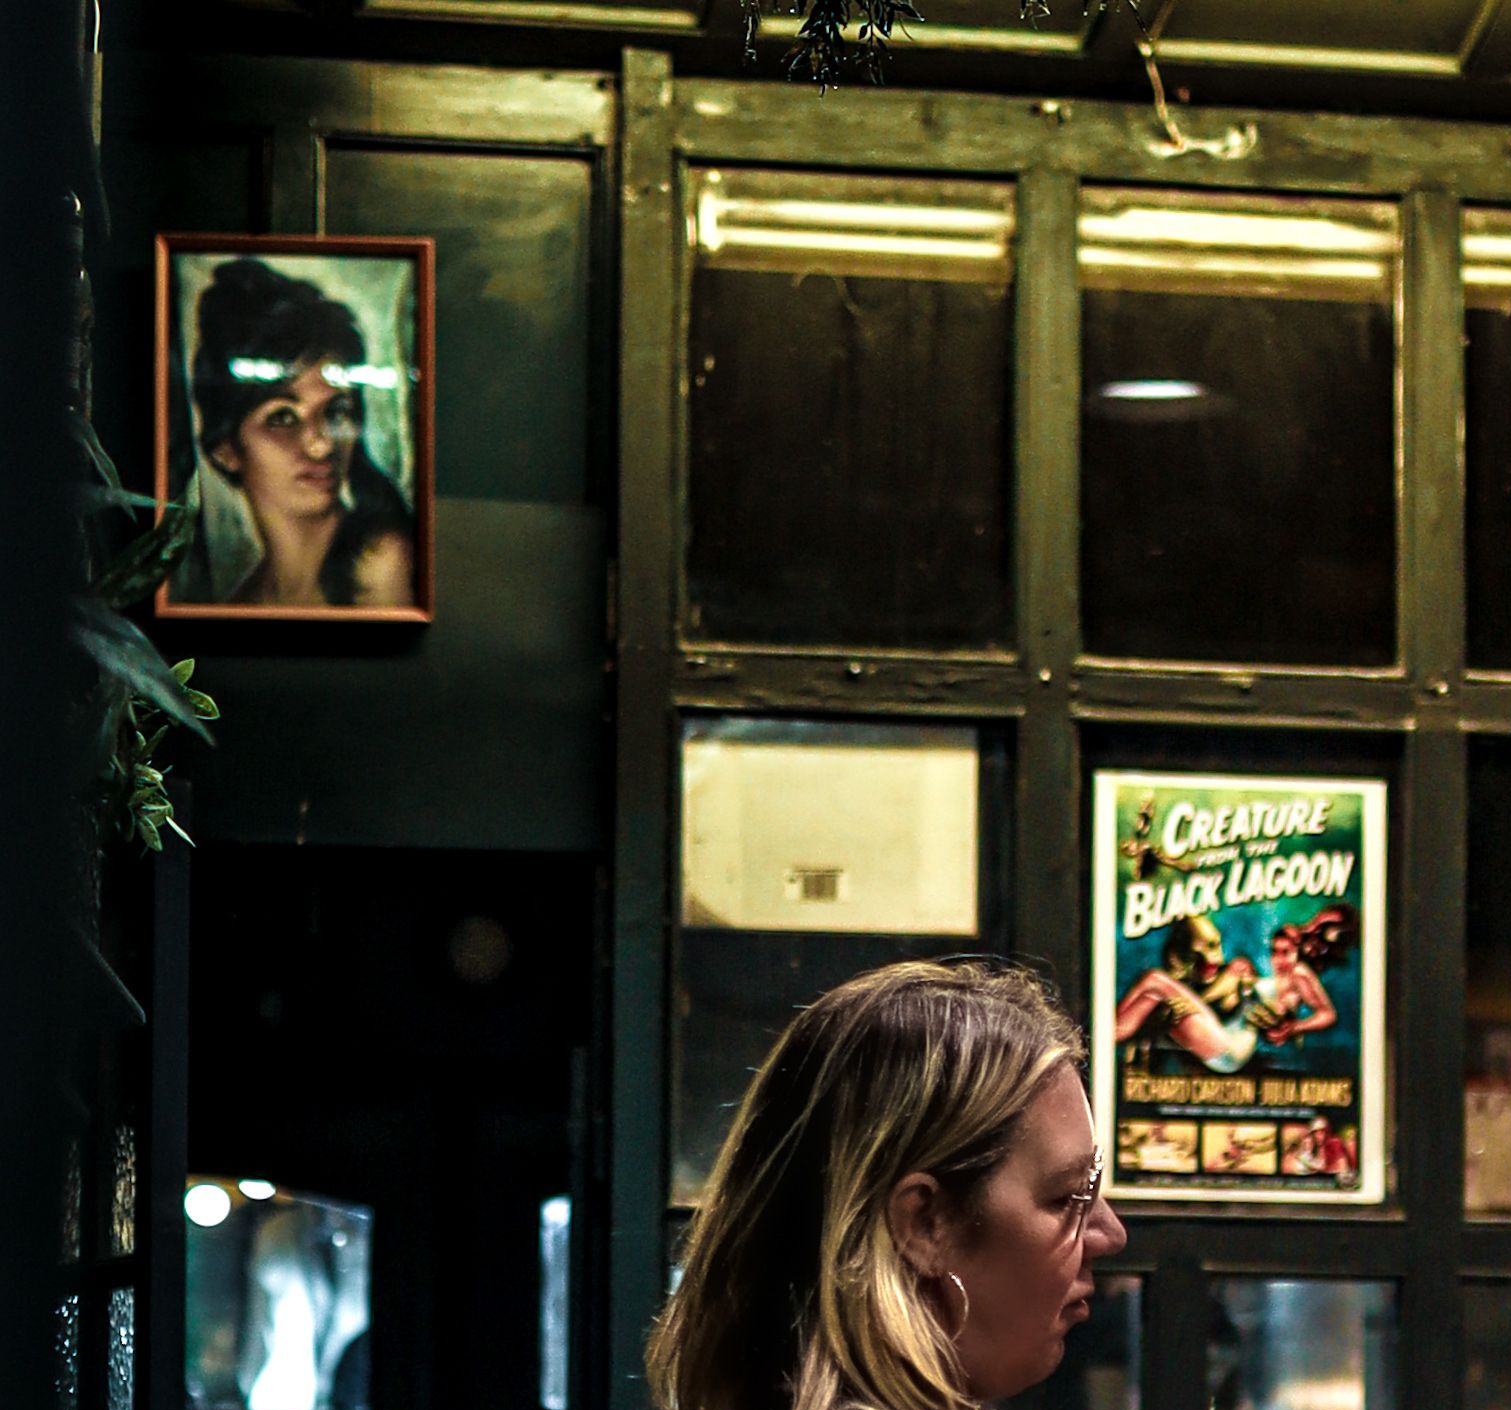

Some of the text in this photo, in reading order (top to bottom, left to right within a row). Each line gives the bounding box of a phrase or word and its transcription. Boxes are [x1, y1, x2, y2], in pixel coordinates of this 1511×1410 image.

[1163, 799, 1333, 860] CREATURE
[1123, 852, 1354, 938] BLACK LAGOON
